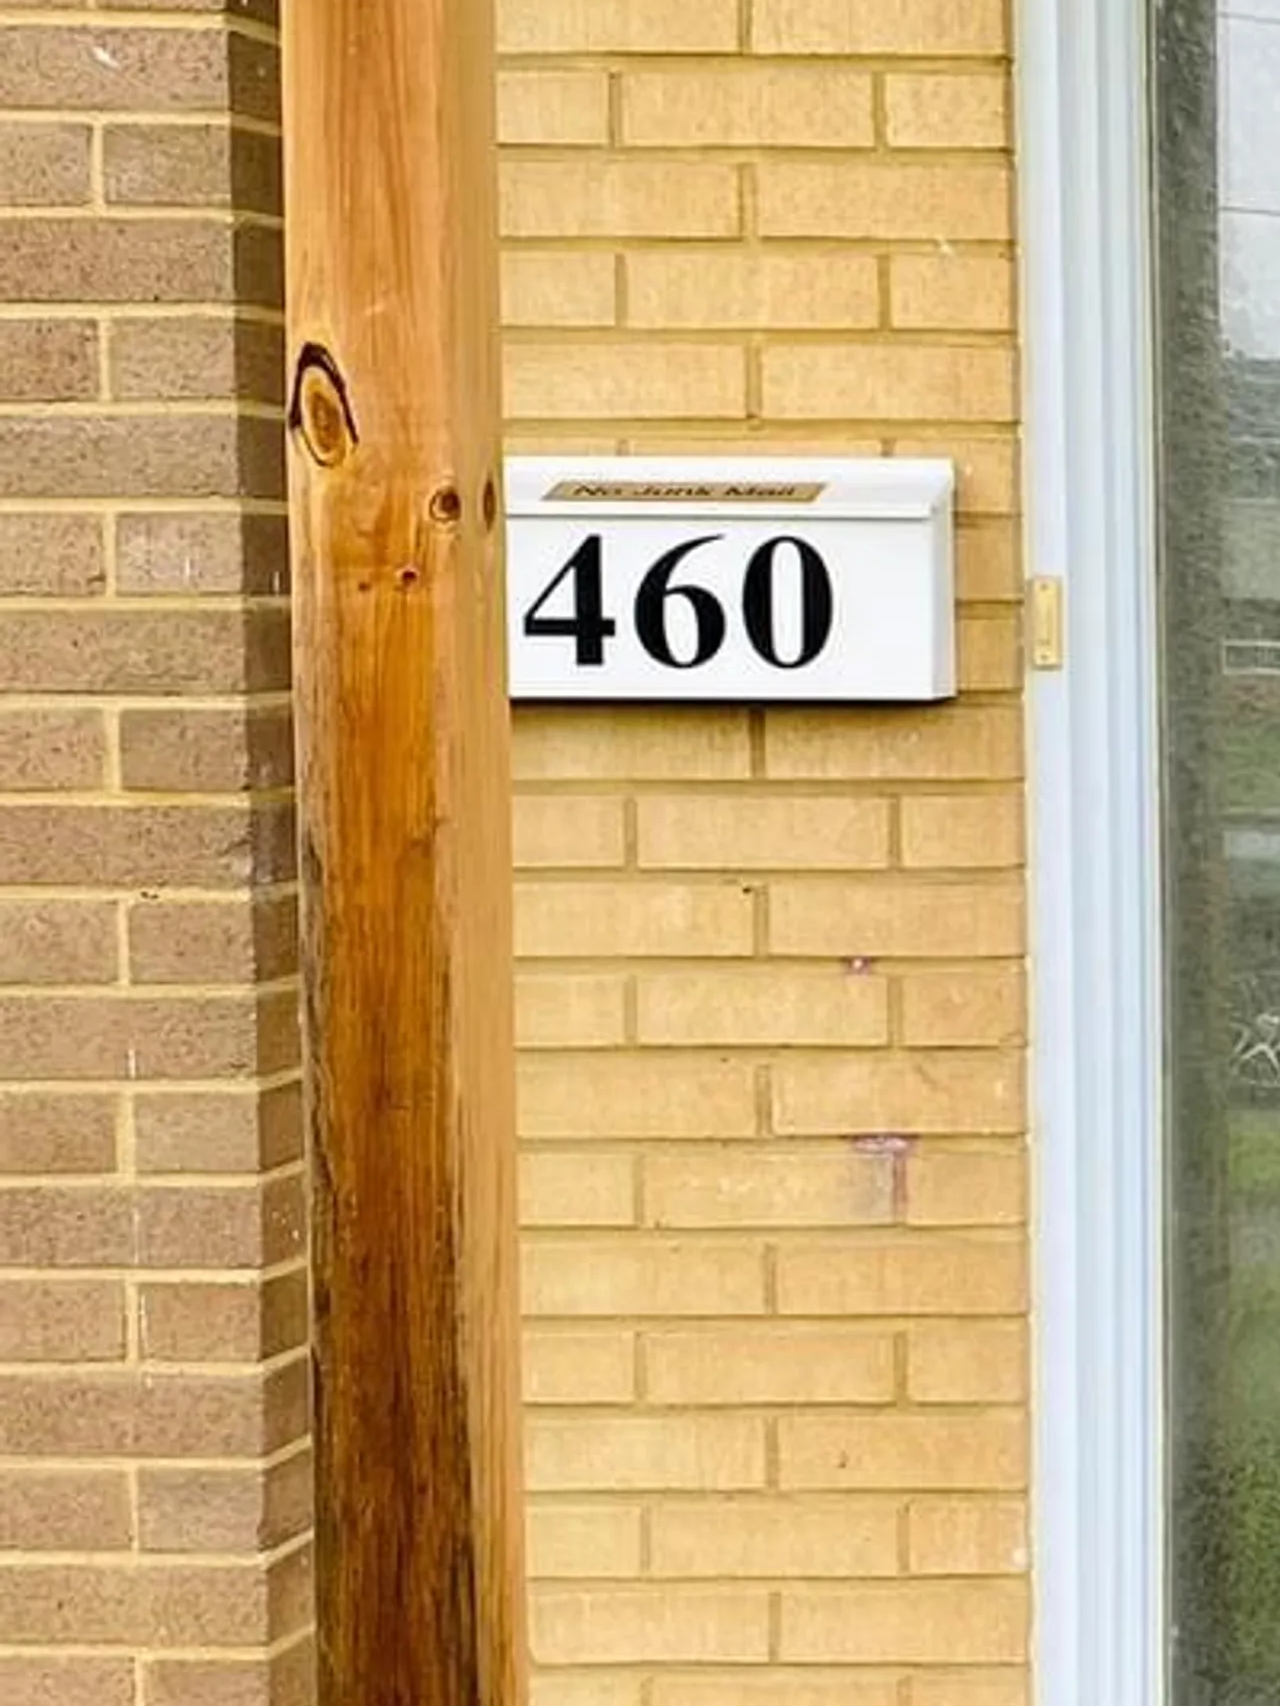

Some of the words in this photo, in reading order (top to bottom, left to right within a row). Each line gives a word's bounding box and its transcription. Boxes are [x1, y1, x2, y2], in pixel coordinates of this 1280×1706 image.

[573, 484, 621, 498] No
[634, 484, 713, 498] Junk
[724, 484, 796, 498] Mail
[523, 533, 833, 669] 460
